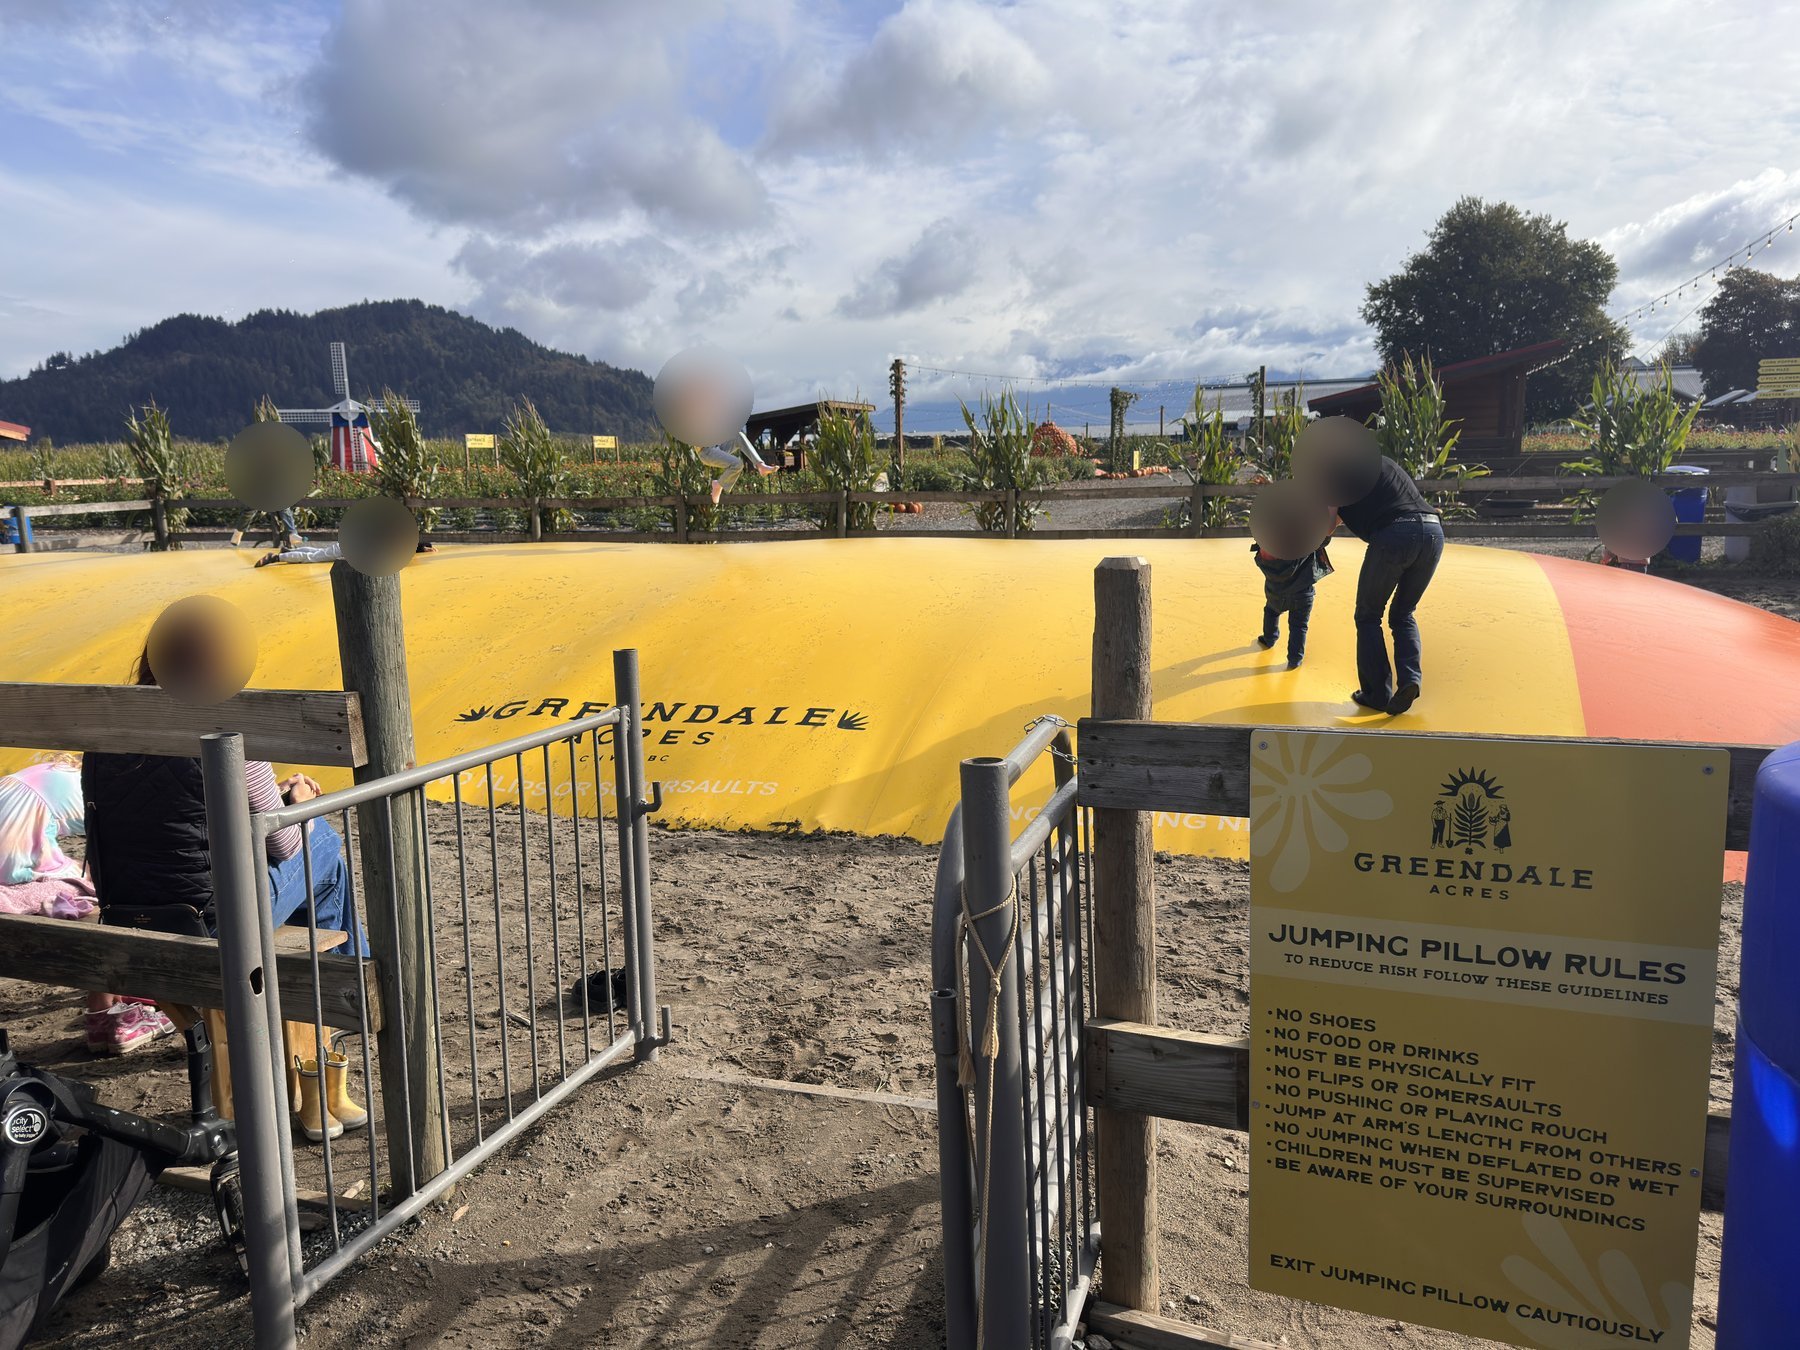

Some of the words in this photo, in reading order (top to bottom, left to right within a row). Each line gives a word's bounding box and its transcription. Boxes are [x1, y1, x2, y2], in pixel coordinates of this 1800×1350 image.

[492, 698, 836, 727] GRENDALE
[1354, 853, 1592, 889] GREENDALE
[1430, 885, 1508, 900] ACRES
[1268, 924, 1408, 956] JUMPING
[1421, 939, 1552, 970] PILLOW
[1565, 954, 1686, 984] RULES
[1284, 953, 1303, 964] TO
[1309, 956, 1373, 972] REDUCE
[1379, 965, 1417, 977] RISK
[1423, 969, 1489, 984] FOLLOW
[1496, 977, 1551, 992] THESE
[1558, 984, 1668, 1004] GUIDELINES
[1277, 1008, 1302, 1022] NO
[1310, 1012, 1376, 1032] SHOES
[1274, 1027, 1300, 1041] NO
[1308, 1032, 1361, 1049] FOOD
[1368, 1040, 1395, 1054] OR
[1403, 1044, 1479, 1065] DRINKS
[1275, 1045, 1327, 1063] MUST
[1335, 1054, 1361, 1068] BE
[1369, 1059, 1494, 1086] PHYSICALLY
[1502, 1077, 1535, 1092] FIT
[1275, 1065, 1300, 1078] NO
[1308, 1070, 1363, 1088] FLIPS
[1371, 1079, 1398, 1093] OR
[1407, 1084, 1561, 1117] SOMERSAULTS
[1275, 1083, 1300, 1097] NO
[1308, 1088, 1392, 1112] PUSHING
[1400, 1103, 1428, 1117] OR
[1436, 1107, 1523, 1131] PLAYING
[1532, 1122, 1606, 1144] ROUGH
[11, 1125, 32, 1133] select
[1273, 1103, 1326, 1119] JUMP
[1333, 1112, 1356, 1125] AT
[1362, 1117, 1419, 1135] ARM'S
[1428, 1126, 1511, 1150] LENGTH
[1520, 1141, 1581, 1161] FROM
[1590, 1151, 1681, 1176] OTHERS
[1274, 1121, 1299, 1135] NO
[1306, 1127, 1392, 1151] JUMPING
[1400, 1141, 1459, 1162] WHEN
[1468, 1152, 1581, 1181] DEFLATED
[1590, 1172, 1620, 1187] OR
[1628, 1178, 1679, 1196] WET
[1275, 1140, 1371, 1166] CHILDREN
[1380, 1157, 1434, 1176] MUST
[1442, 1167, 1470, 1182] BE
[1477, 1173, 1614, 1206] SUPERVISED
[1275, 1157, 1300, 1172] BE
[1307, 1164, 1373, 1184] AWARE
[1380, 1176, 1407, 1189] OF
[1414, 1181, 1468, 1201] YOUR
[1475, 1192, 1645, 1231] SURROUNDINGS
[1271, 1254, 1315, 1273] EXIT
[1321, 1266, 1416, 1295] JUMPING
[1423, 1285, 1509, 1313] PILLOW
[1516, 1304, 1664, 1343] CAUTIOUSLY
